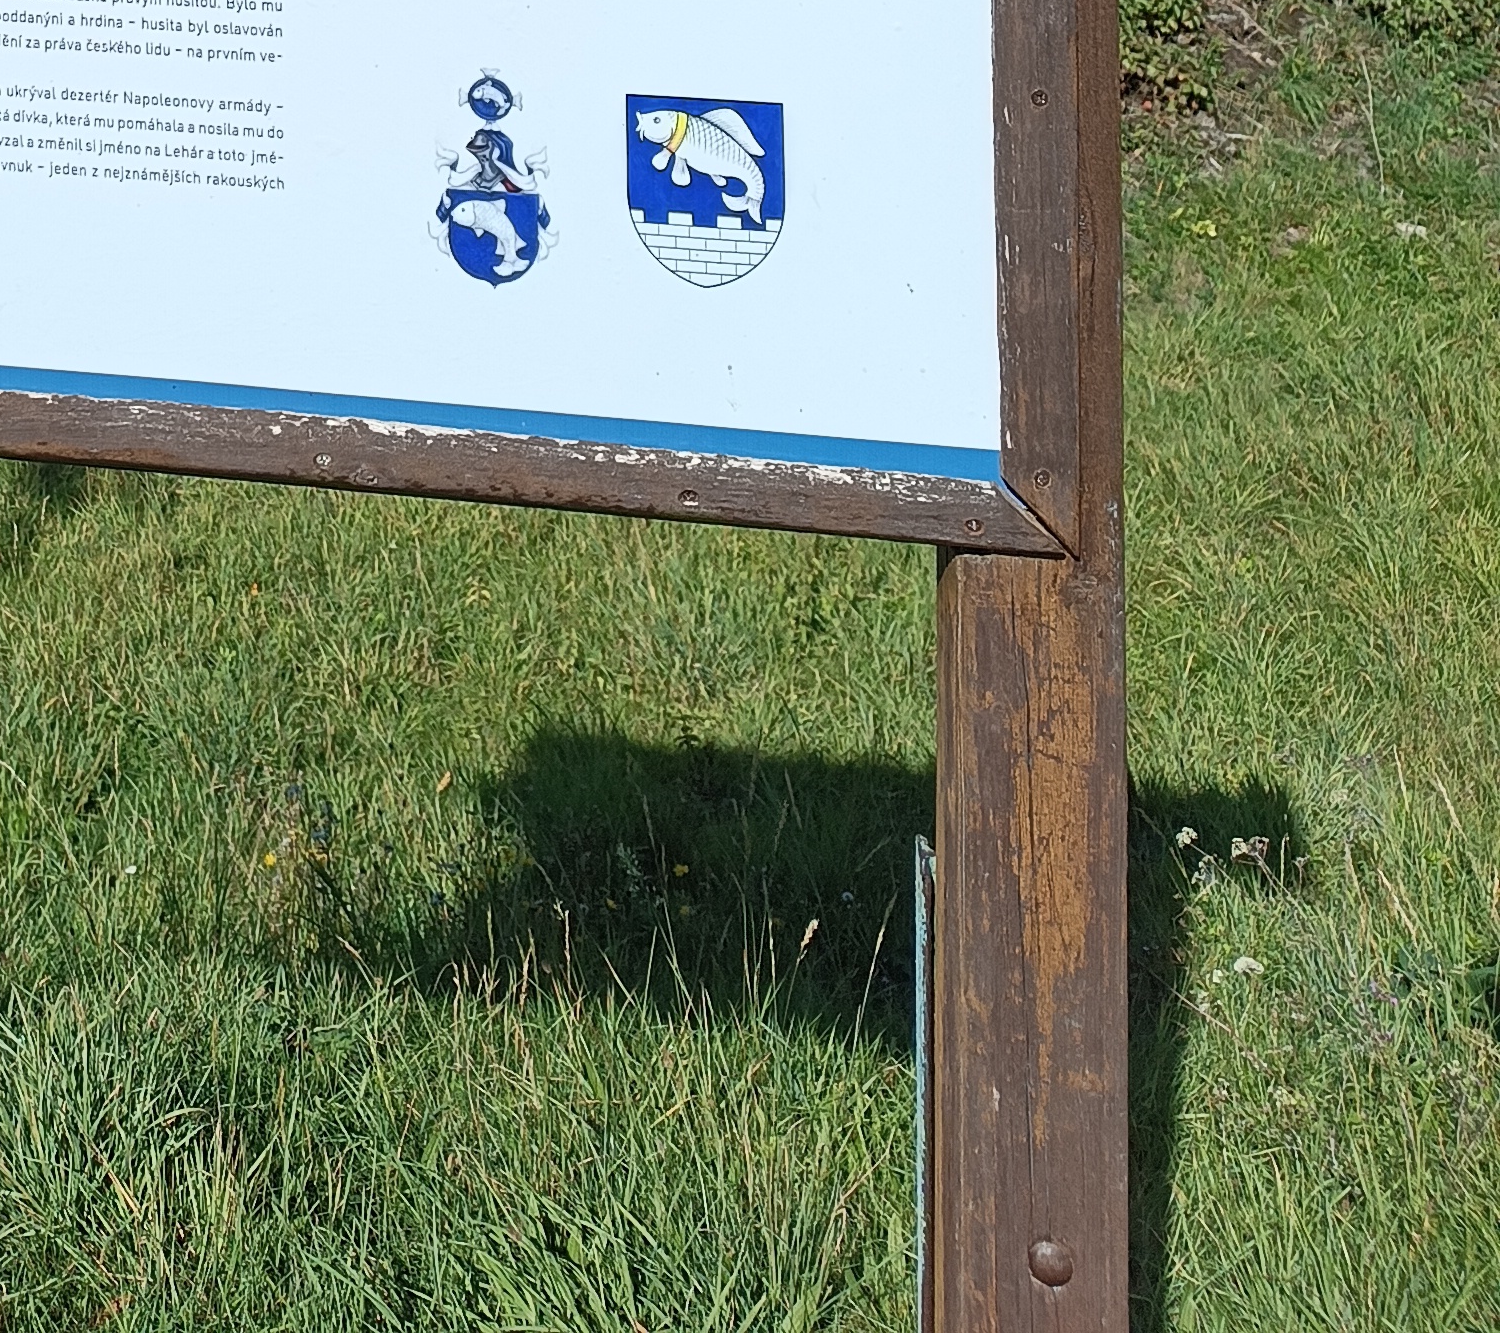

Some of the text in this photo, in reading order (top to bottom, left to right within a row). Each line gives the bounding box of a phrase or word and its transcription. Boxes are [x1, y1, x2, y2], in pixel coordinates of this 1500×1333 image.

[48, 161, 87, 178] jeden
[91, 166, 99, 178] z
[103, 165, 202, 187] nejznámějších
[206, 172, 285, 193] rakouských
